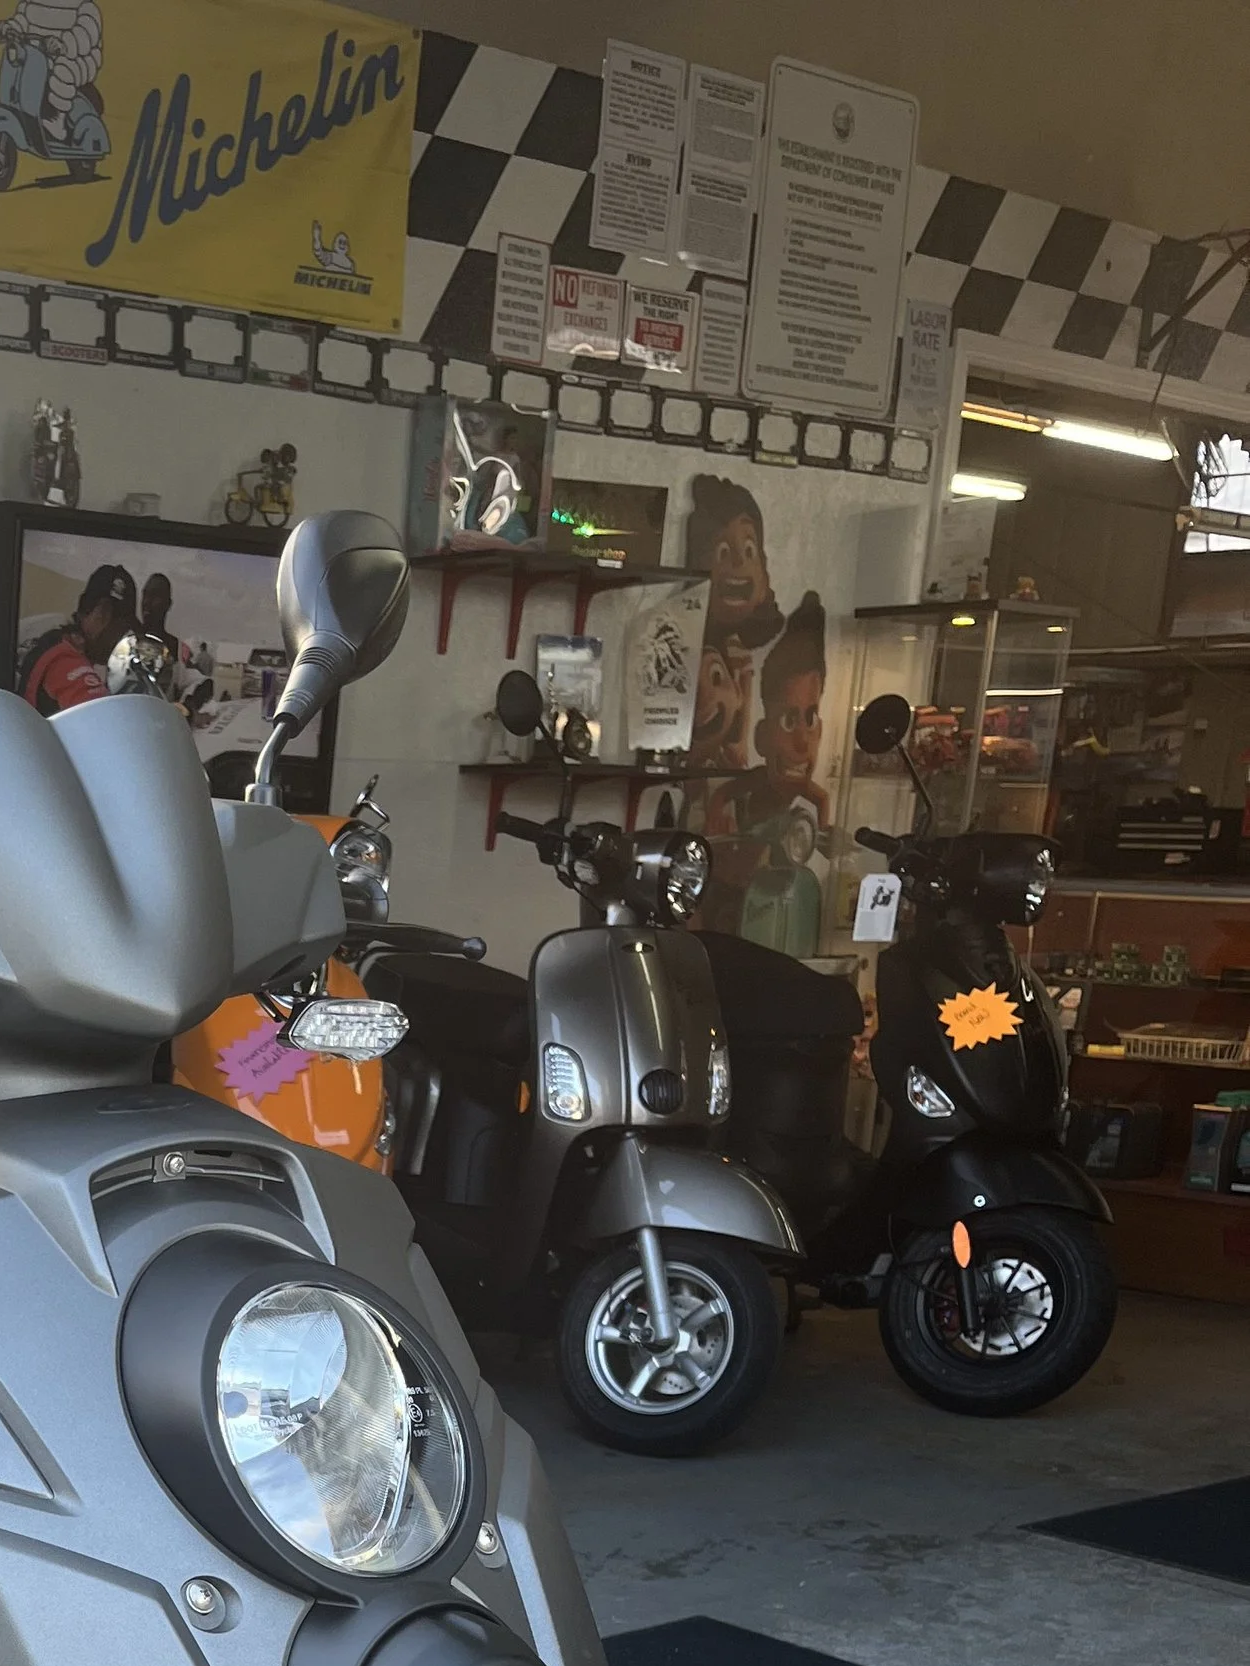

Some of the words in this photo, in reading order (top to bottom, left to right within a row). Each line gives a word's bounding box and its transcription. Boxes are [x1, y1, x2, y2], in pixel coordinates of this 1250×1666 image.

[85, 29, 405, 268] Michelin
[294, 271, 372, 295] MICHELIN
[554, 273, 578, 305] NO
[581, 279, 618, 300] REFUNDS
[633, 290, 648, 304] WE
[650, 294, 690, 312] RESERVE
[564, 311, 608, 332] EXCHANGES
[658, 309, 679, 321] RIGHT
[910, 310, 947, 331] LABOR
[913, 331, 940, 350] RATE
